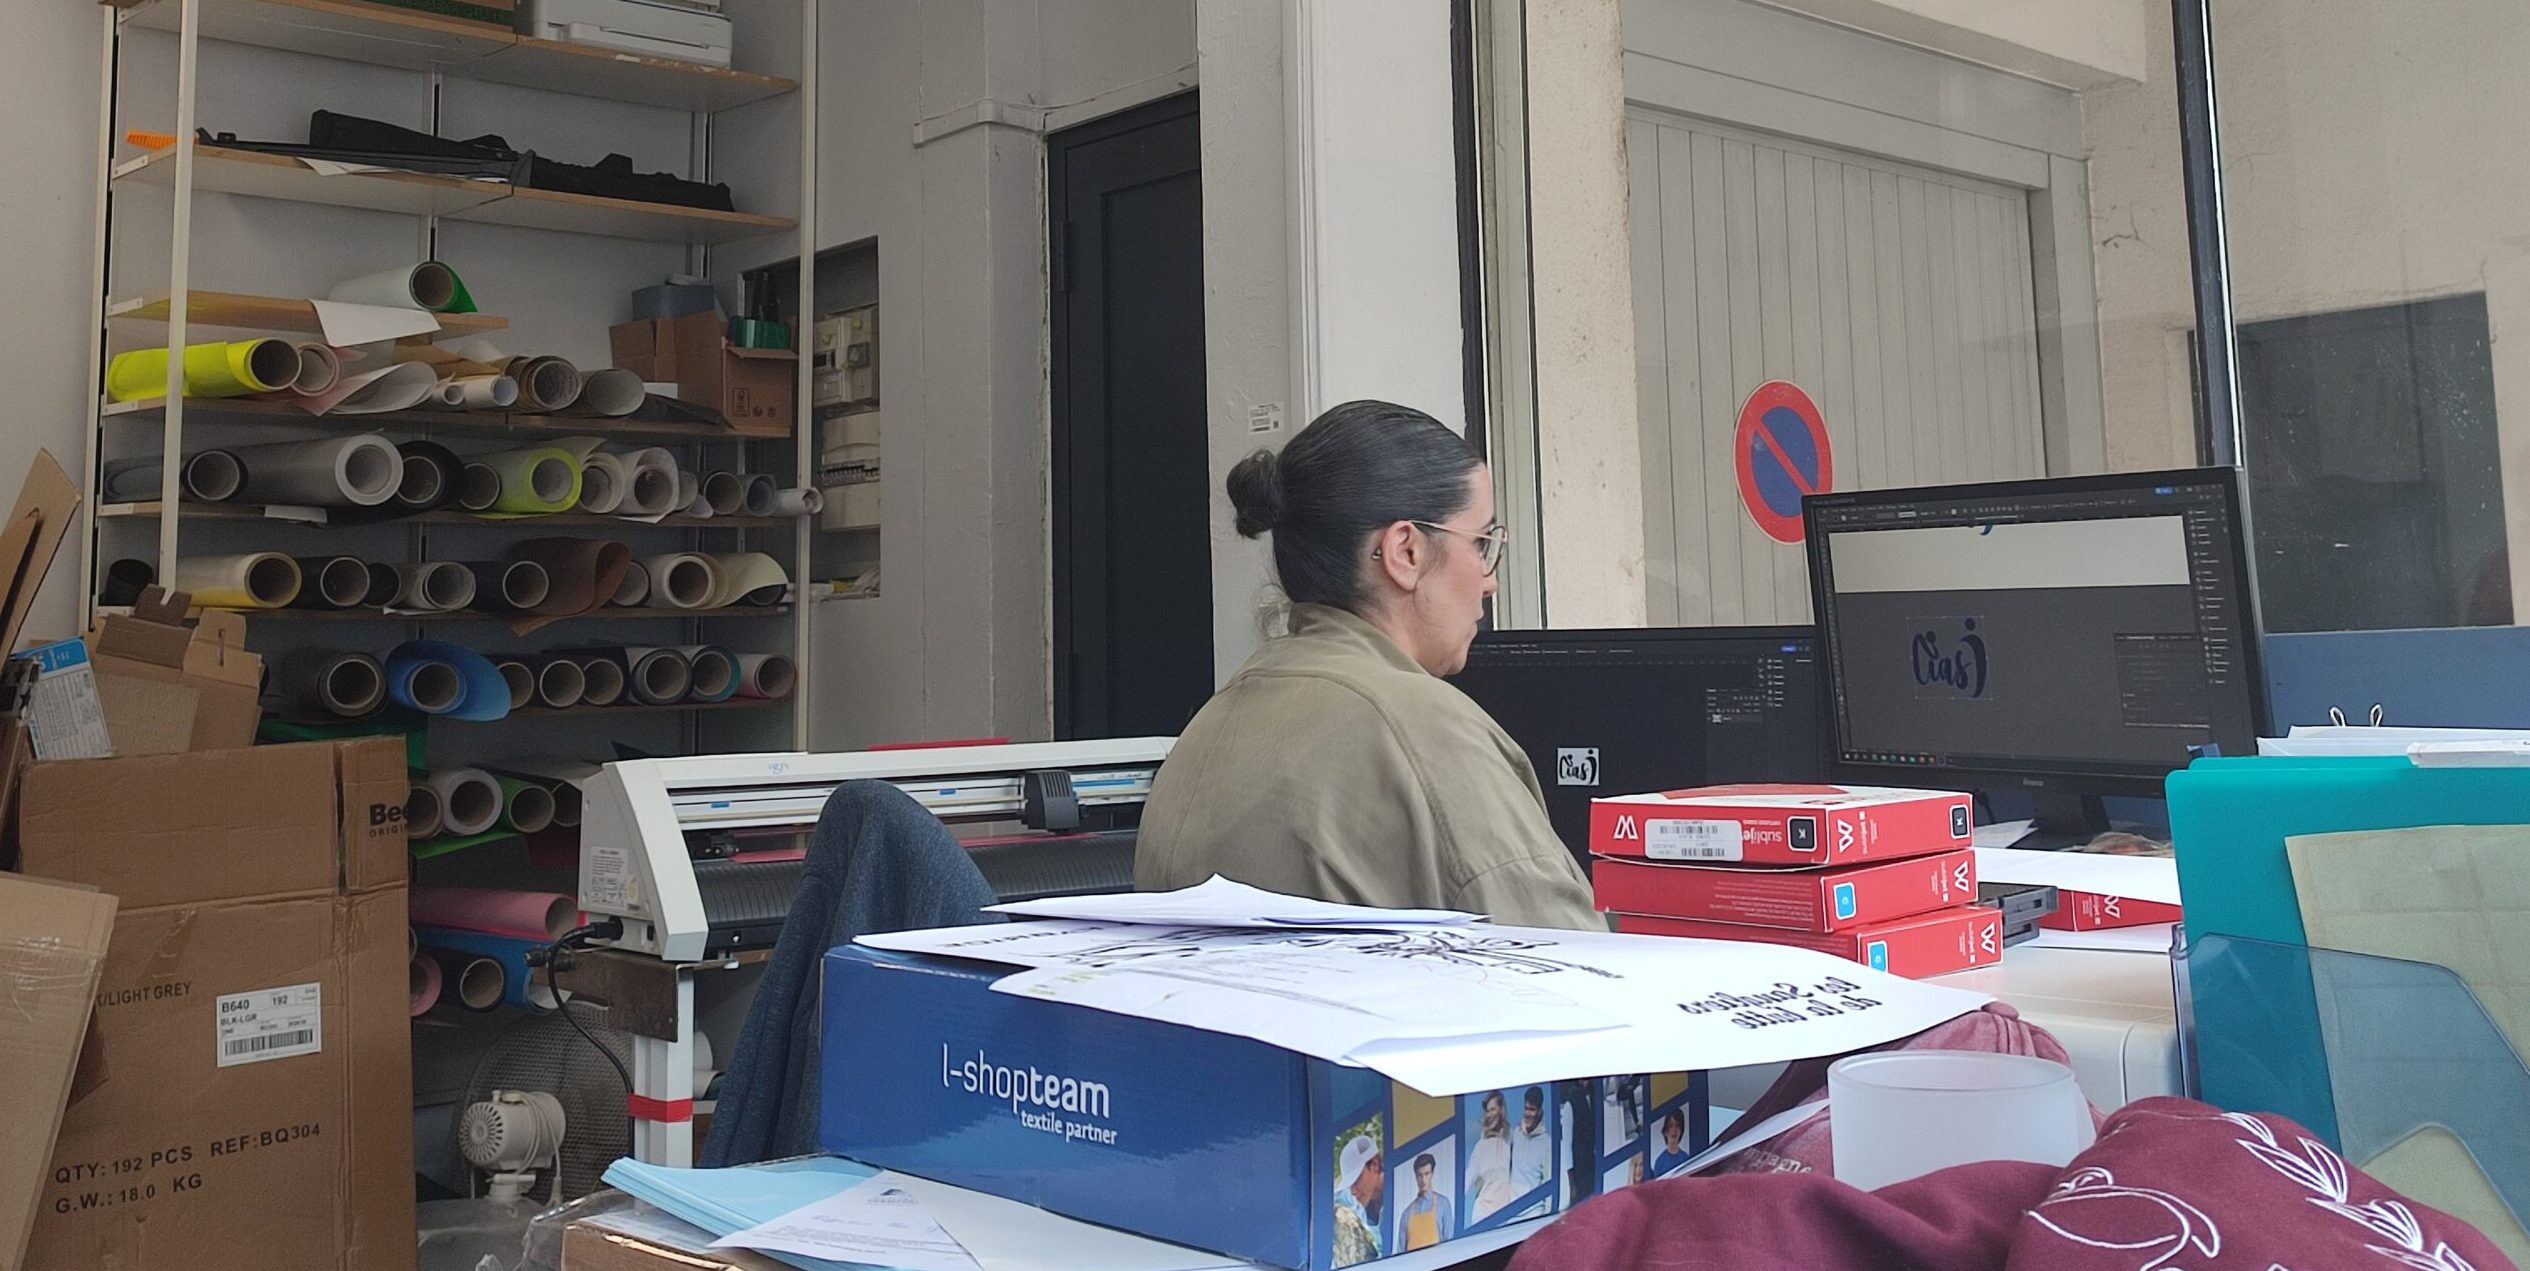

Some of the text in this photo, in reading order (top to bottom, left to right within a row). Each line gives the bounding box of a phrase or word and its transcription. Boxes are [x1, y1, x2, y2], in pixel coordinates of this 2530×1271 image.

[1742, 827, 1783, 845] sublije
[153, 981, 192, 1000] GREY
[222, 994, 288, 1013] B640 192
[942, 1043, 1110, 1119] l-shopteam
[1020, 1110, 1118, 1145] textile partner
[55, 1162, 106, 1184] QTY:
[112, 1157, 143, 1174] 192
[150, 1145, 193, 1168] PCS
[55, 1173, 203, 1214] G.W.: 18.0 KG
